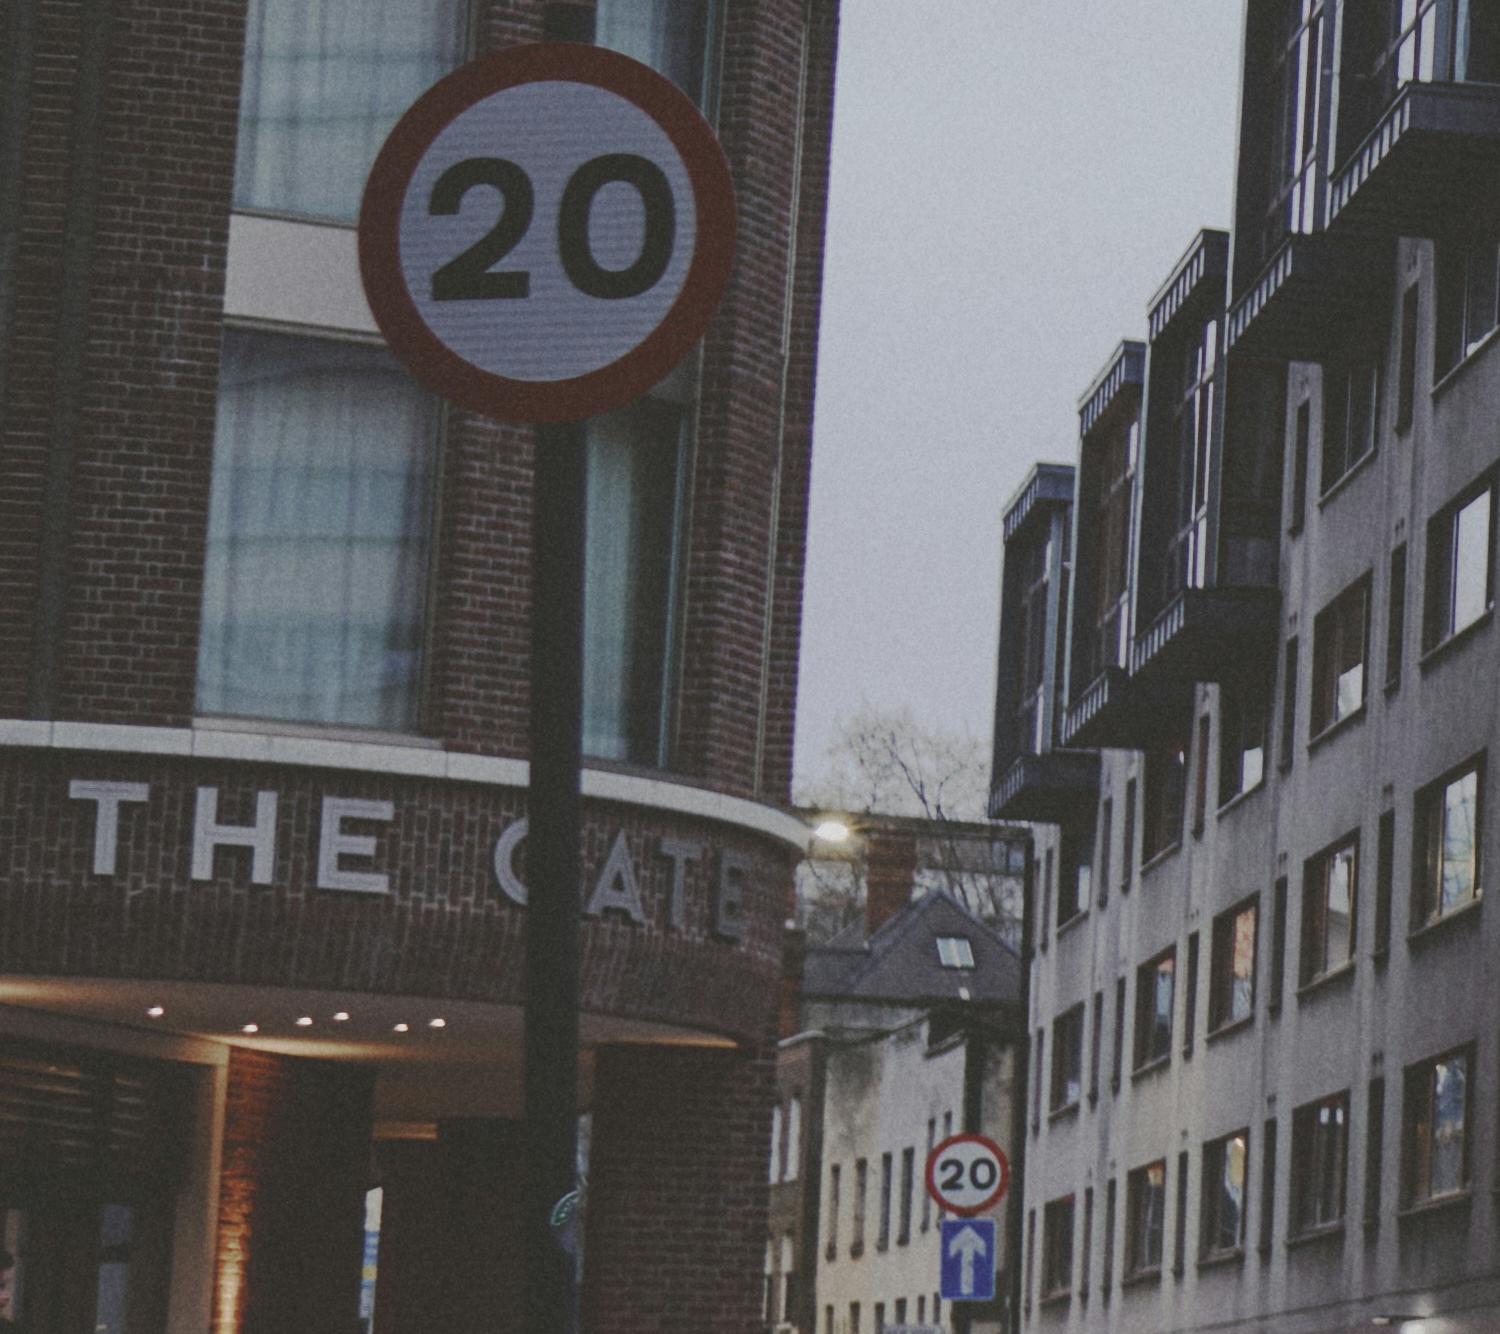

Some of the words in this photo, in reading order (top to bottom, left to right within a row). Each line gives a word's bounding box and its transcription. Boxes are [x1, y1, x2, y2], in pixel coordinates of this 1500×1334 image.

[428, 152, 676, 300] 20
[69, 779, 394, 895] THE
[940, 1158, 996, 1191] 20
